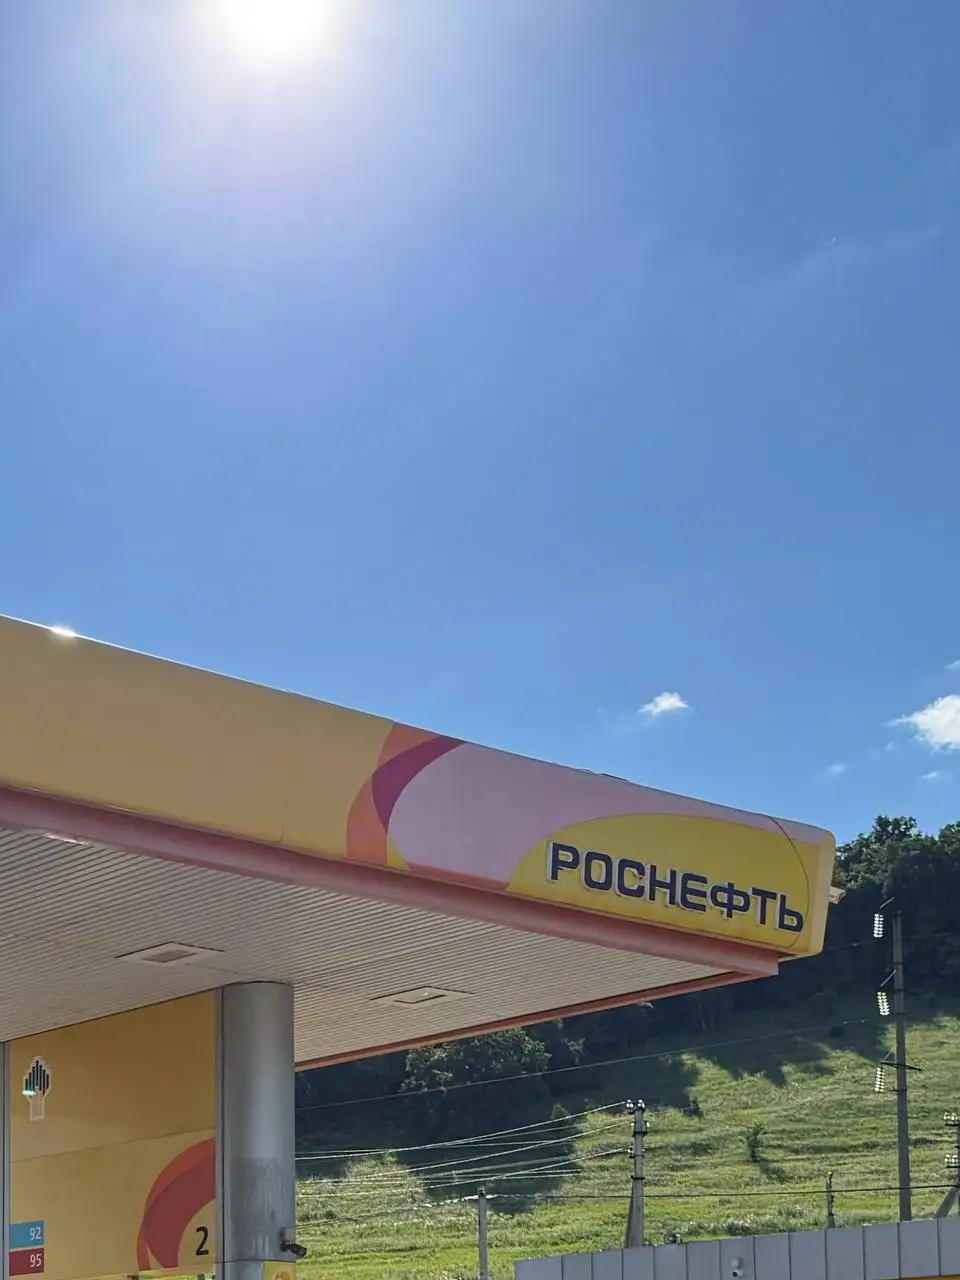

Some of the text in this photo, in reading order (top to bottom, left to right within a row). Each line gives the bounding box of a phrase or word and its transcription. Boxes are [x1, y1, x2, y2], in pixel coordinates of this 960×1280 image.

[548, 840, 804, 933] РОСНЕФТЬ
[29, 1226, 42, 1241] 92
[195, 1225, 210, 1257] 2
[29, 1253, 43, 1268] 95
